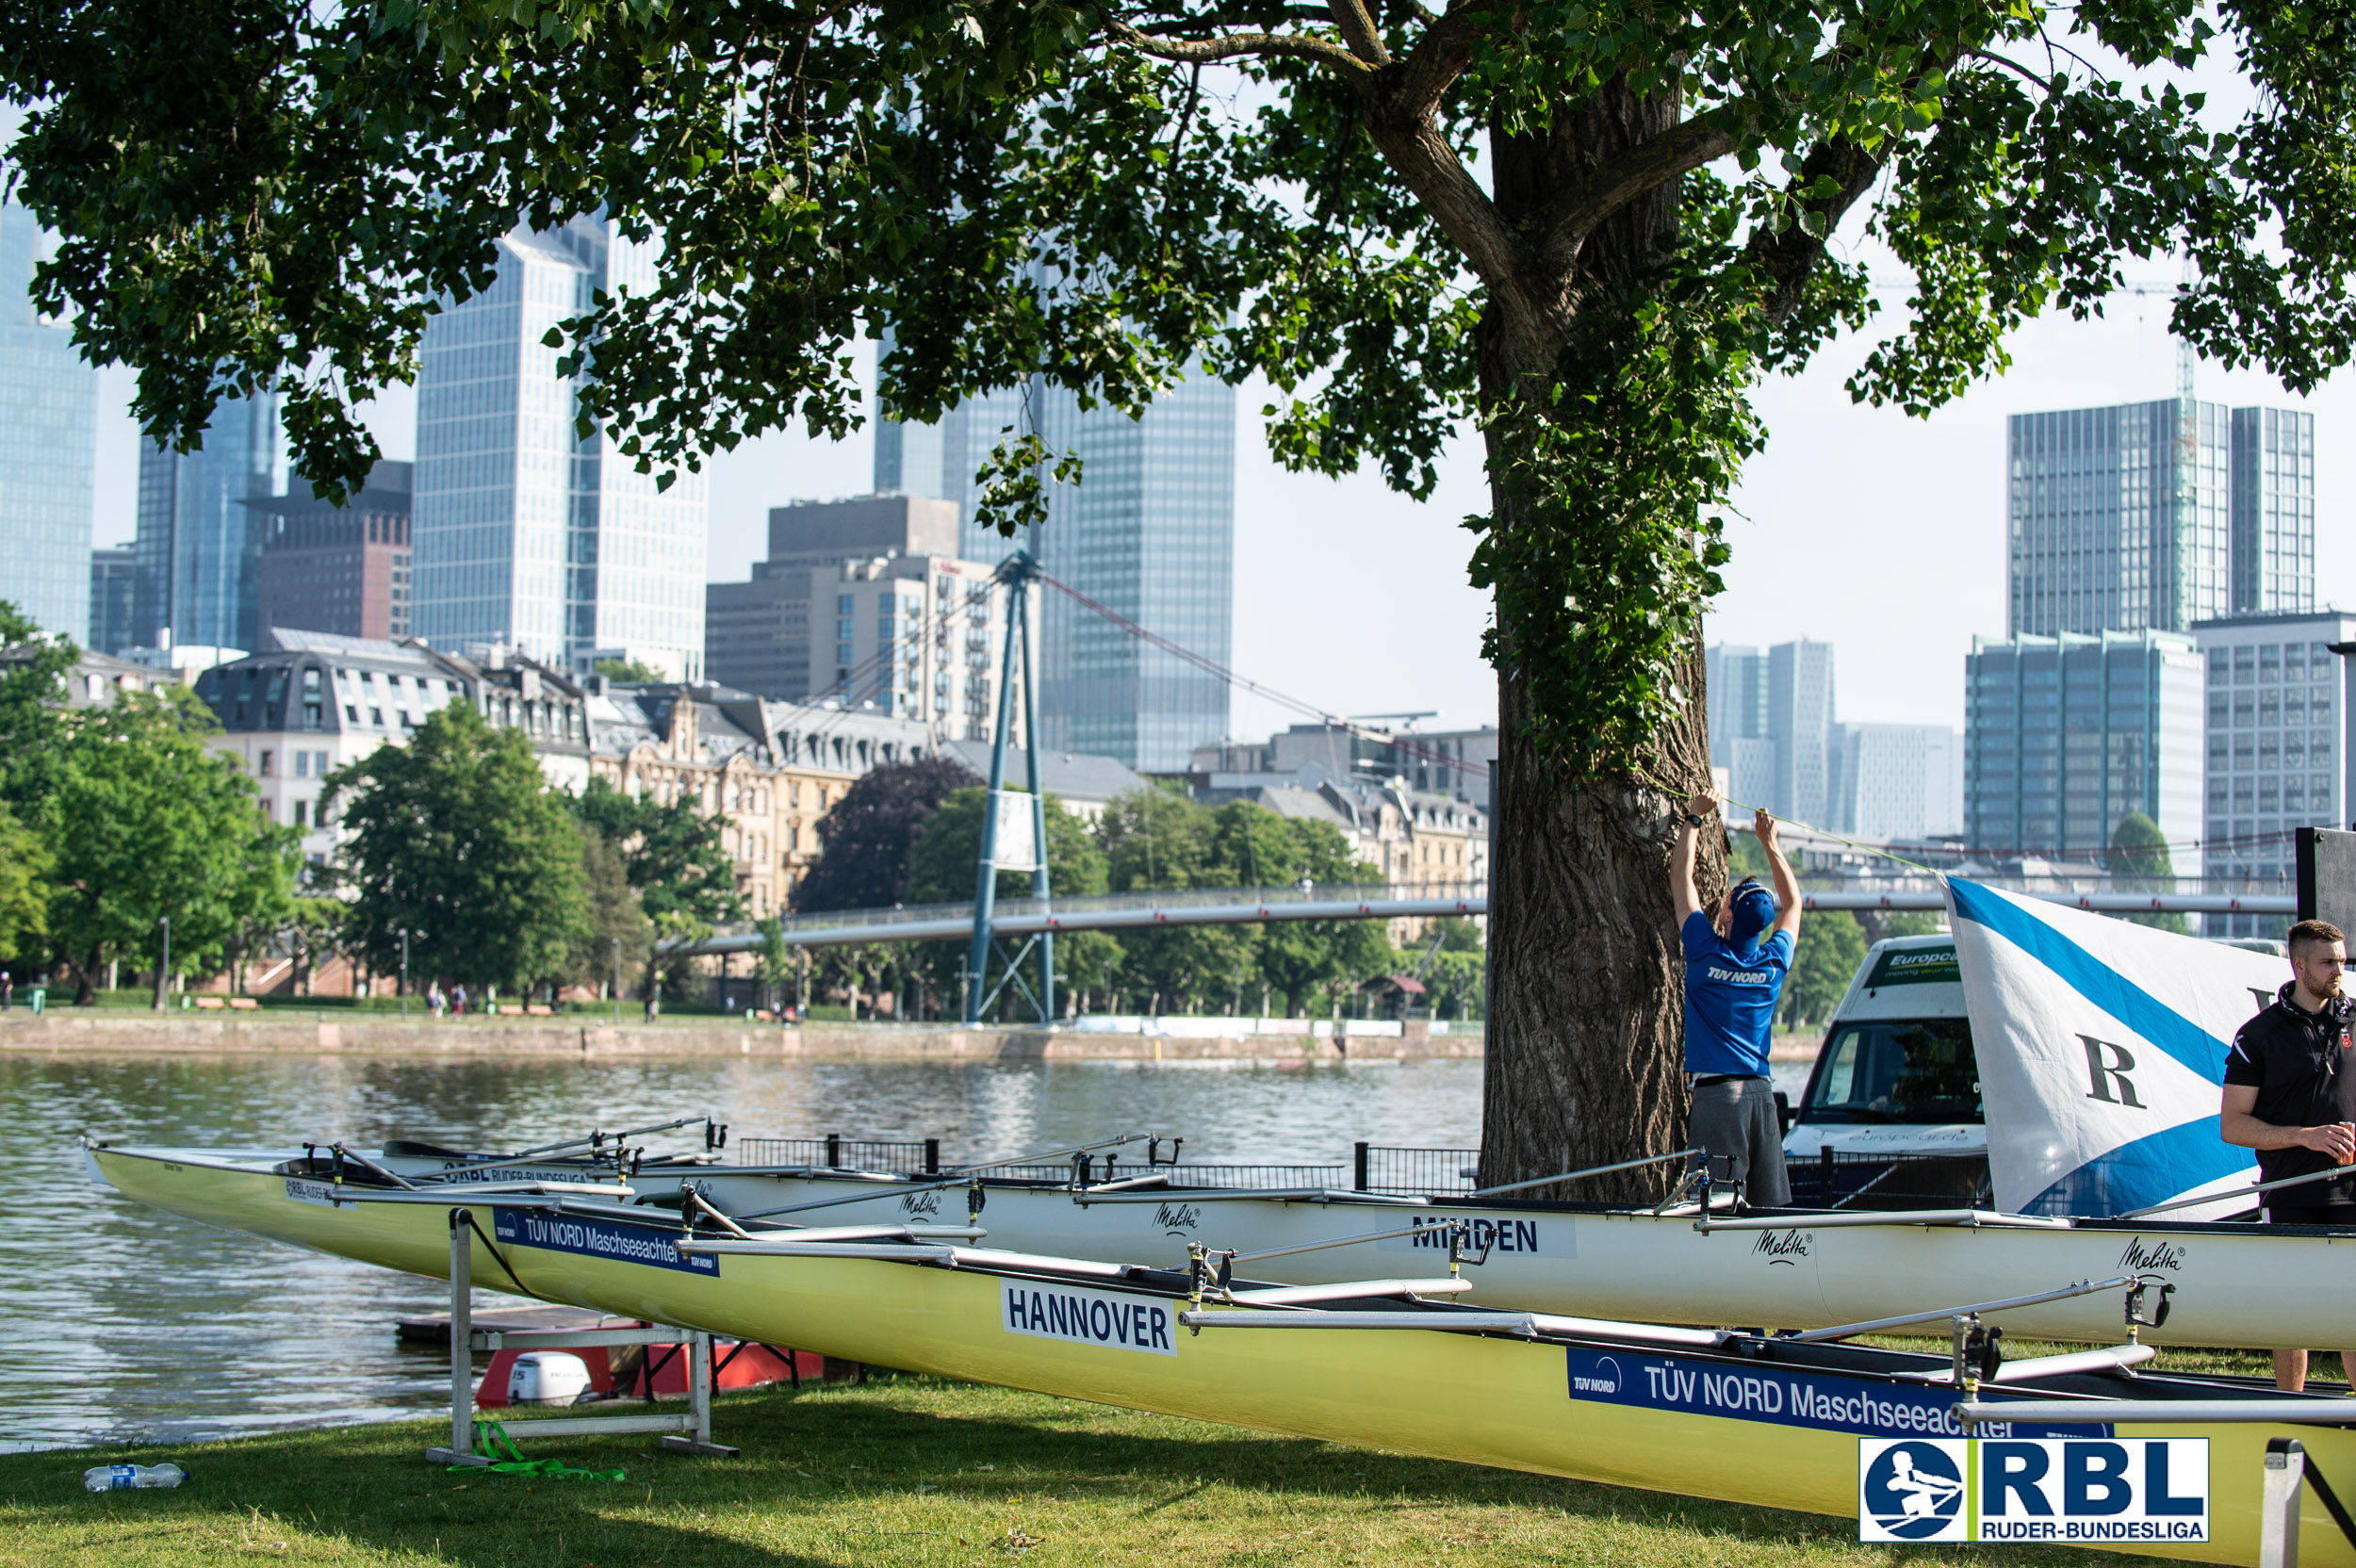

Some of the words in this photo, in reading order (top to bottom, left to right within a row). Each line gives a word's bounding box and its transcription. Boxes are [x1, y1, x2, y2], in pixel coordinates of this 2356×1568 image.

[1890, 952, 1957, 966] Europca
[1730, 972, 1767, 984] NORD
[2074, 1033, 2147, 1110] R
[525, 1215, 548, 1242] TÜV
[549, 1223, 584, 1248] NORD
[1008, 1288, 1170, 1349] HANNOVER
[1591, 1379, 1615, 1394] NORD
[1644, 1361, 1696, 1403] TÜV
[1703, 1373, 1783, 1413] NORD
